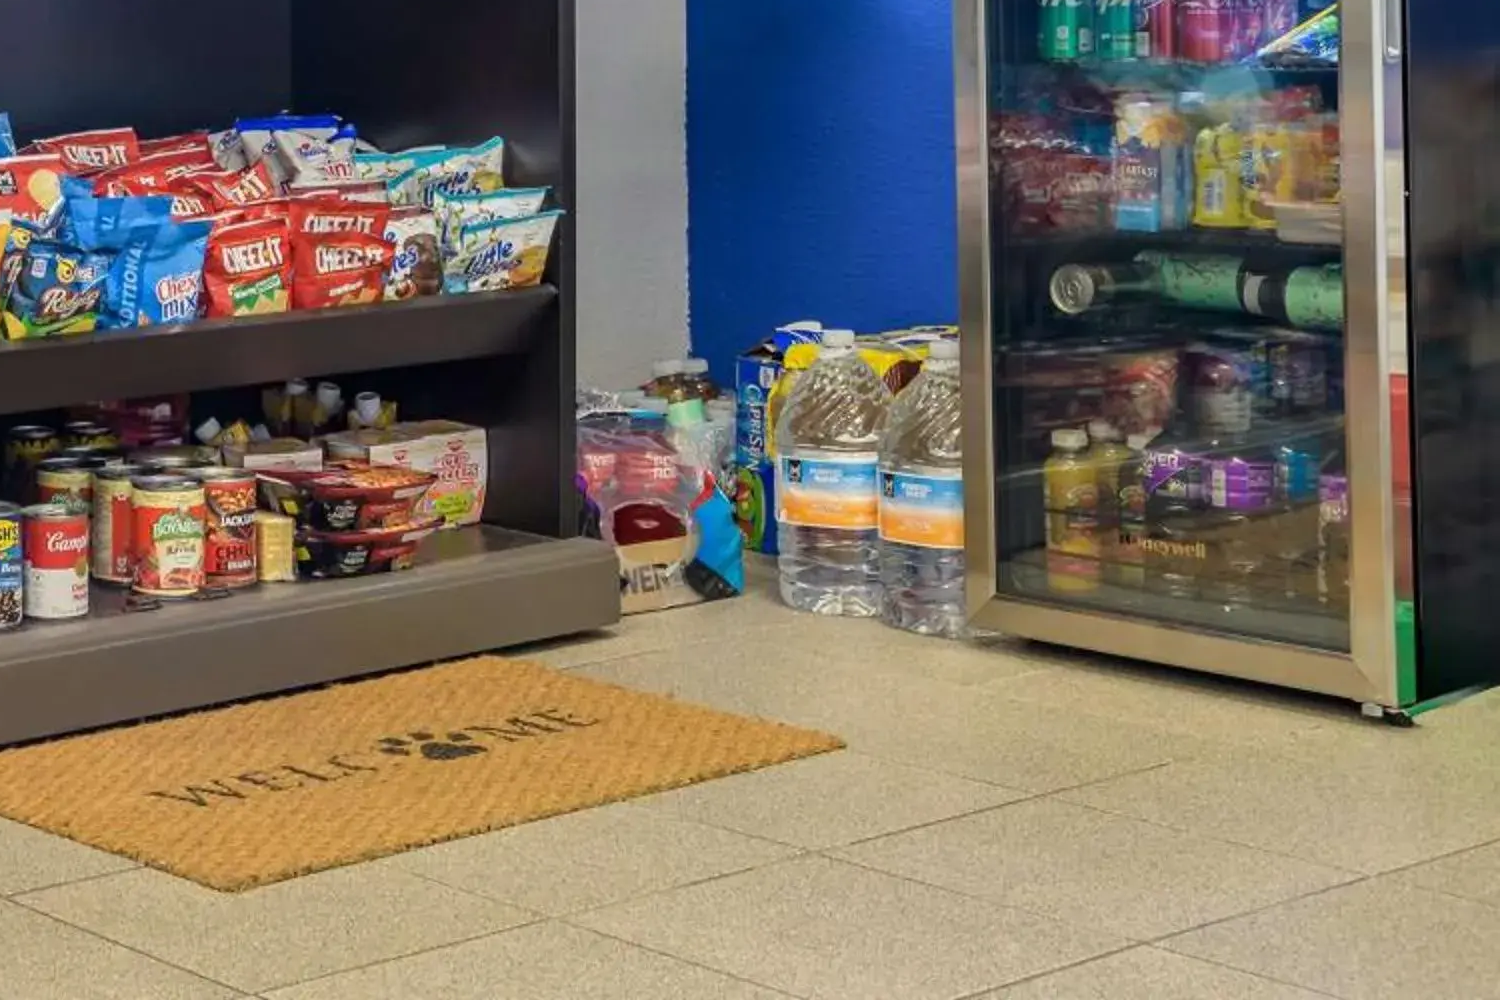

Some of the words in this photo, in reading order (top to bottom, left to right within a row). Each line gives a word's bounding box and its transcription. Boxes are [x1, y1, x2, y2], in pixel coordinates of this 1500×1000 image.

[156, 272, 199, 302] Chex
[1117, 533, 1206, 560] Honeywell
[144, 708, 599, 808] WELCME
